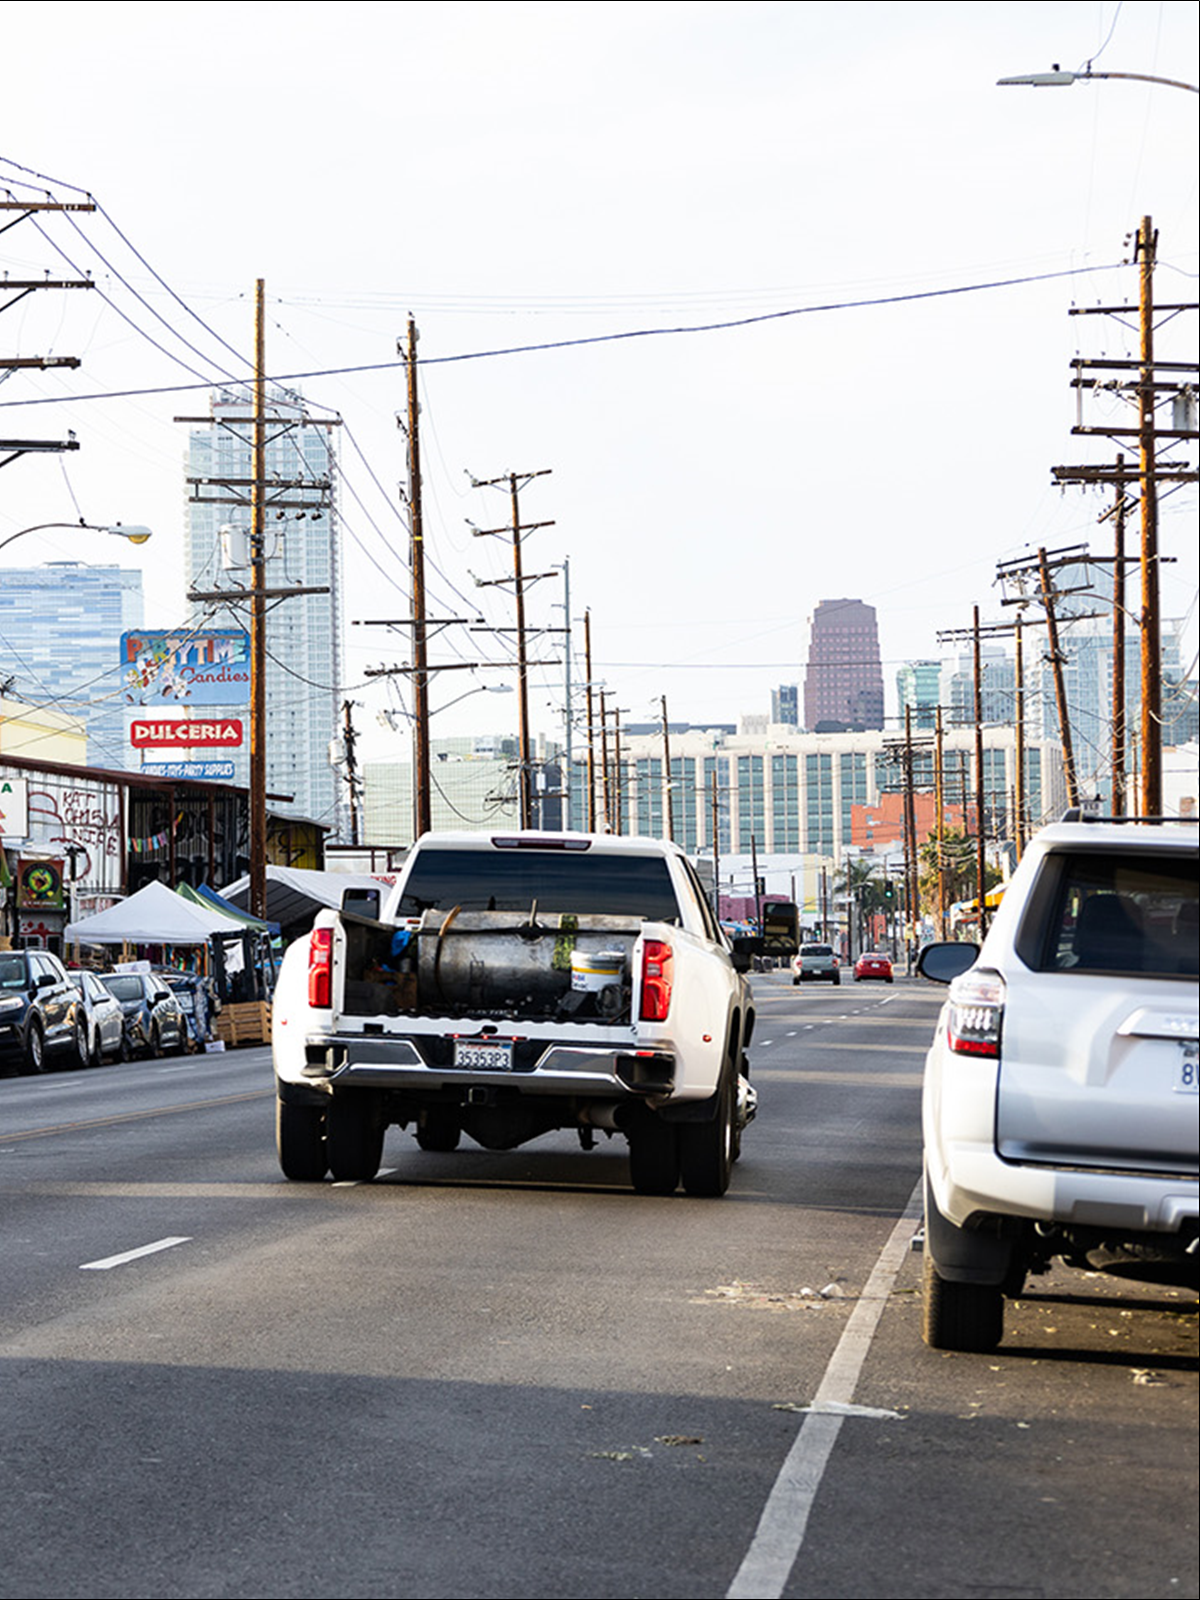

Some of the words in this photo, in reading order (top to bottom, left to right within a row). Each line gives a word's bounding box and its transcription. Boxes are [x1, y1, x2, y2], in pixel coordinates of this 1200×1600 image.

[126, 638, 247, 665] PARTYTIME
[180, 666, 249, 684] Candies
[134, 724, 239, 740] DULCERIA
[457, 1050, 510, 1068] 35353P3
